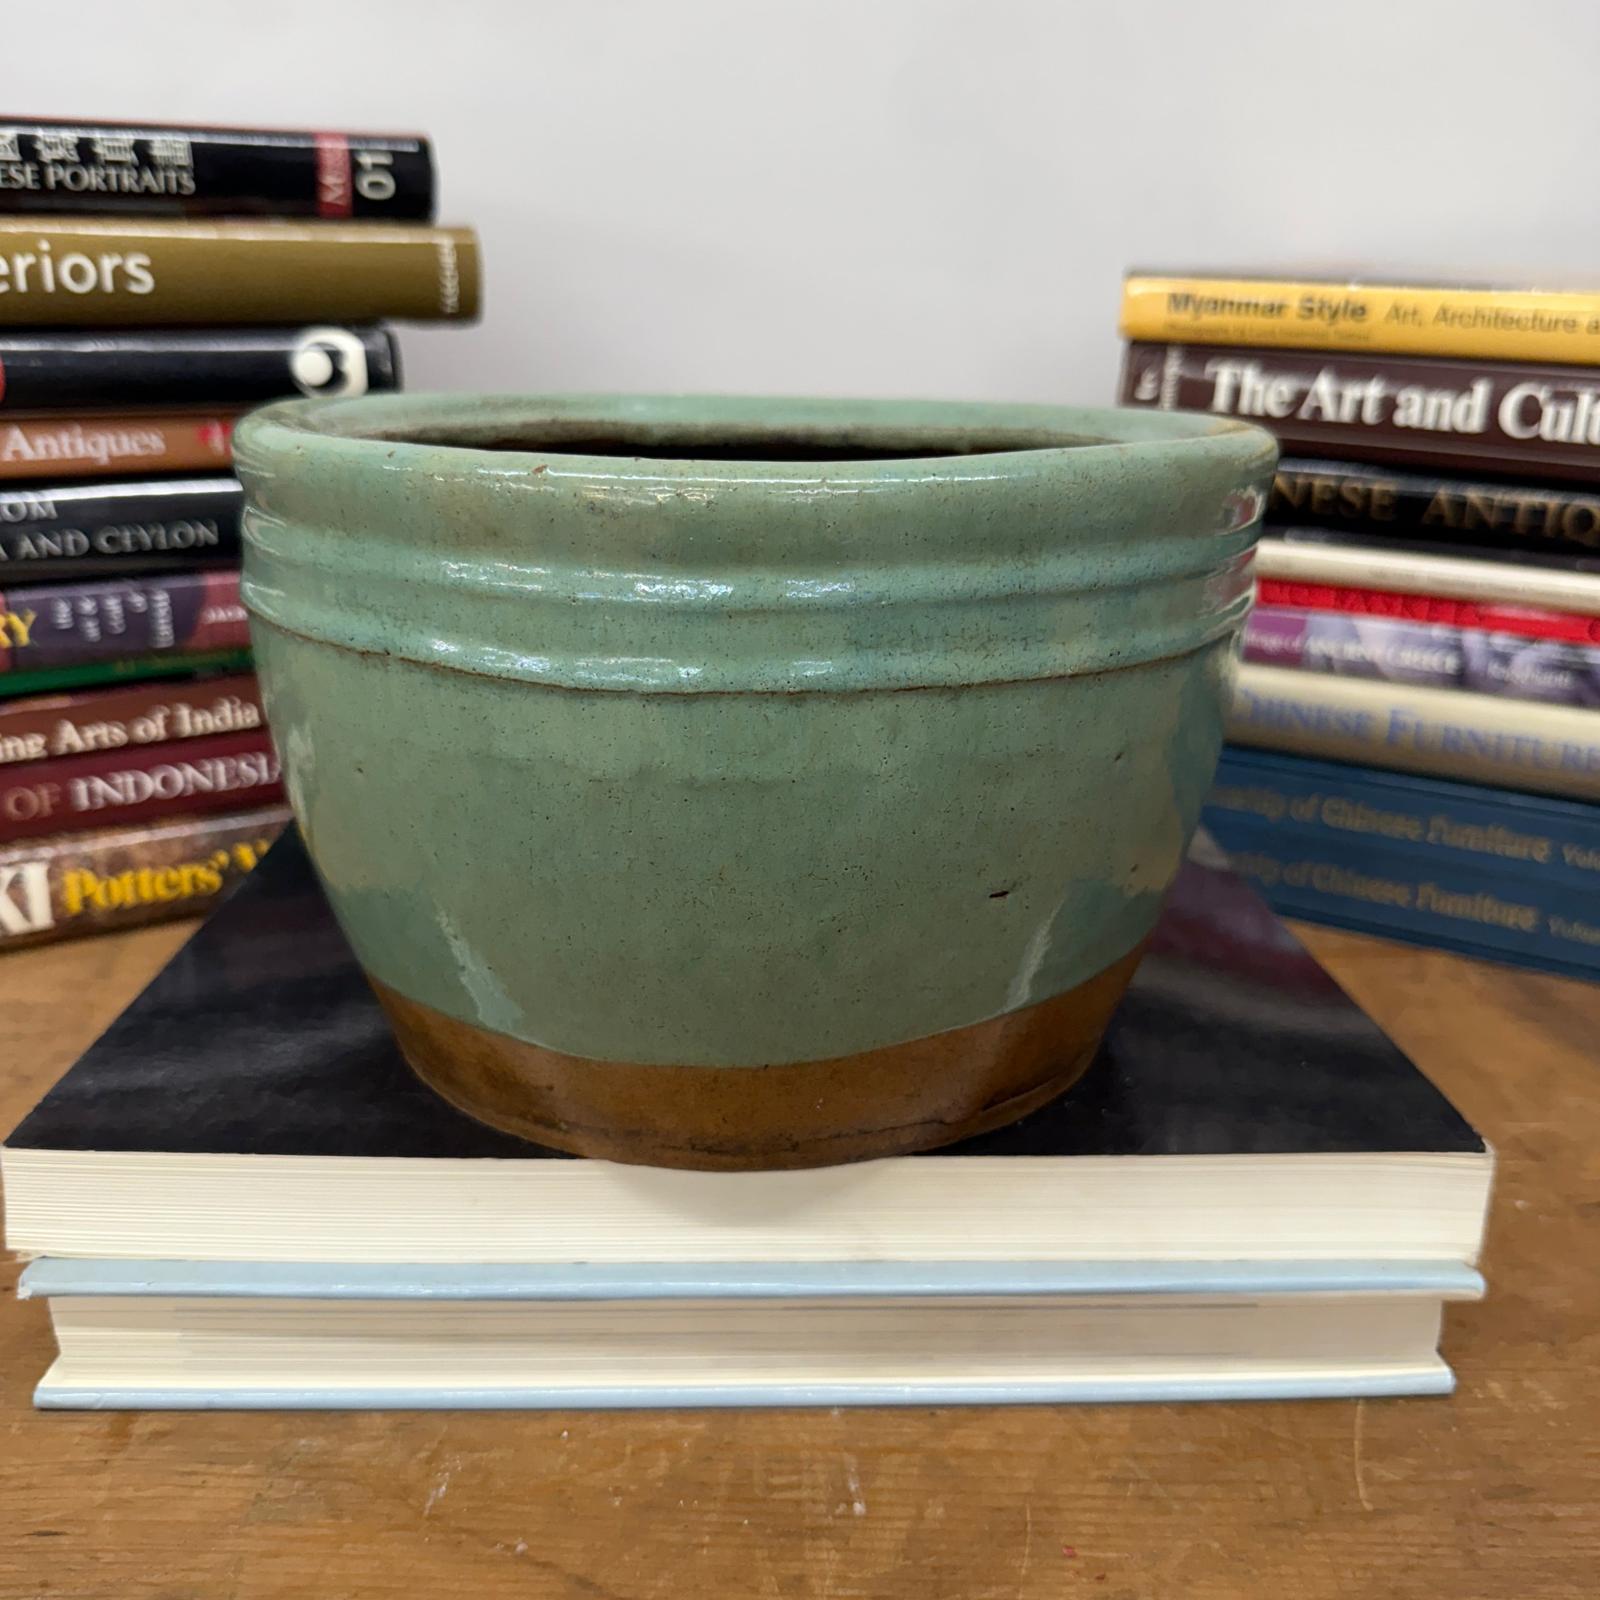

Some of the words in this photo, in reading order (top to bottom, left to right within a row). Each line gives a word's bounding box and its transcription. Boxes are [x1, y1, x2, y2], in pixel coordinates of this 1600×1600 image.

[45, 165, 196, 195] PORTRAITS
[354, 150, 396, 200] 01
[0, 238, 155, 295] riors
[1167, 291, 1288, 320] Myanmar
[1296, 296, 1368, 326] Style
[1434, 304, 1578, 335] Architecture
[1205, 357, 1302, 418] The
[1298, 366, 1388, 427] Art
[1392, 377, 1494, 434] and
[0, 421, 166, 466] Antiques
[15, 527, 91, 560] AND
[94, 518, 219, 555] CEYLON
[53, 717, 129, 755] Arts
[130, 703, 172, 743] of
[172, 695, 262, 739] India
[5, 781, 61, 820] OF
